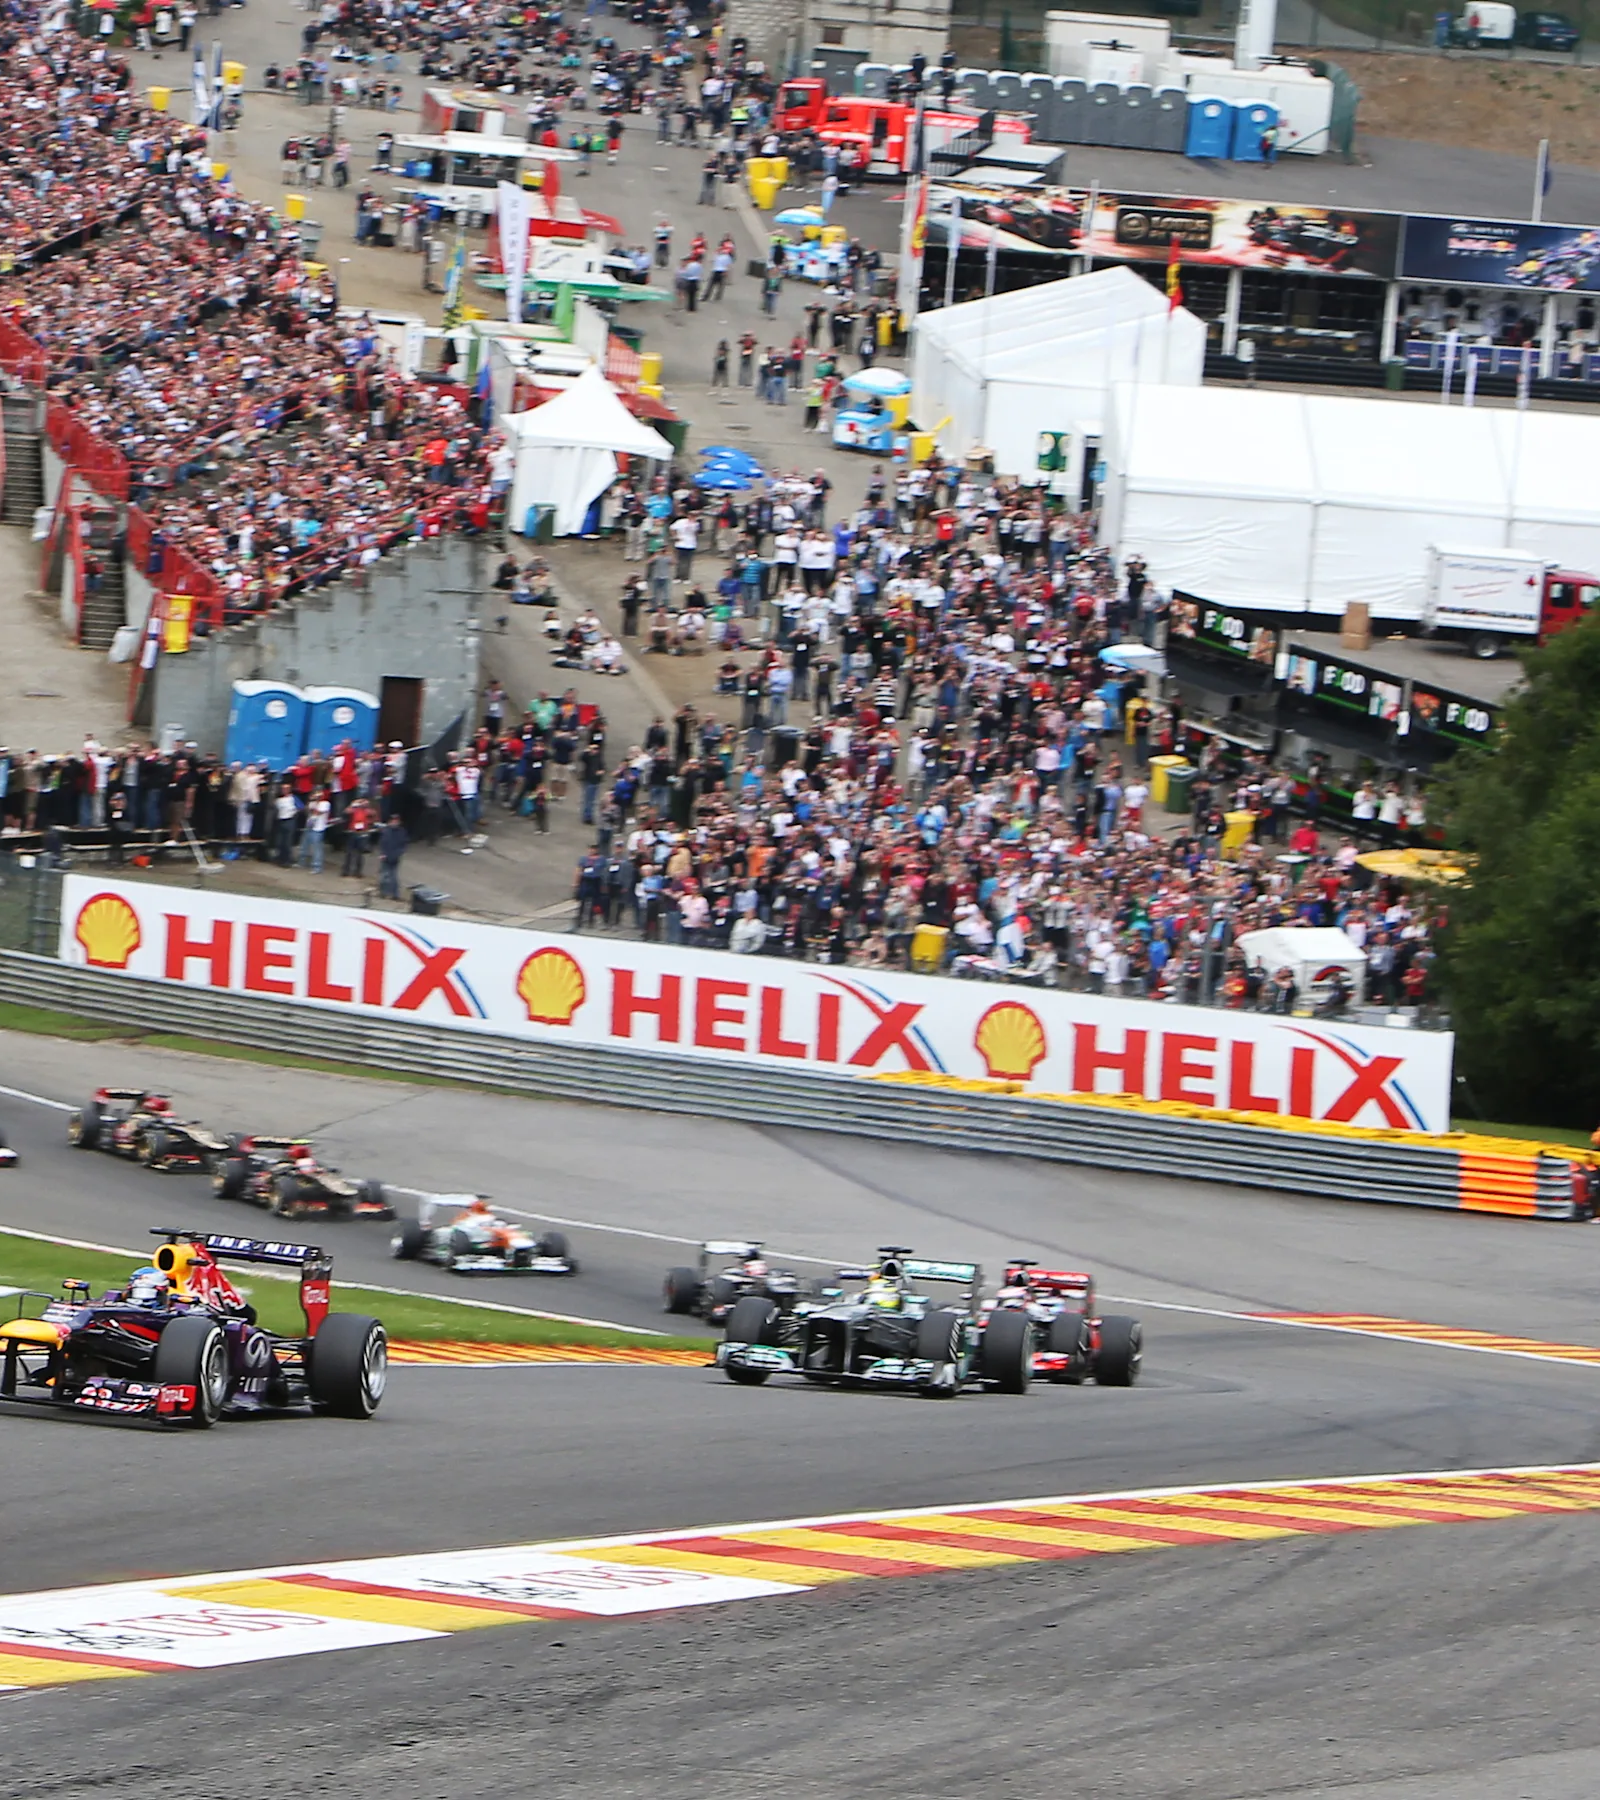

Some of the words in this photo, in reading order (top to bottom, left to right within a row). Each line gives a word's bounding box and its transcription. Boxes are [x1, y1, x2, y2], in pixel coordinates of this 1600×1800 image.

[162, 911, 473, 1018] HELIX
[610, 967, 932, 1073] HELIX
[1072, 1023, 1412, 1131] HELIX
[86, 1607, 328, 1638] UBS
[498, 1564, 710, 1590] UBS
